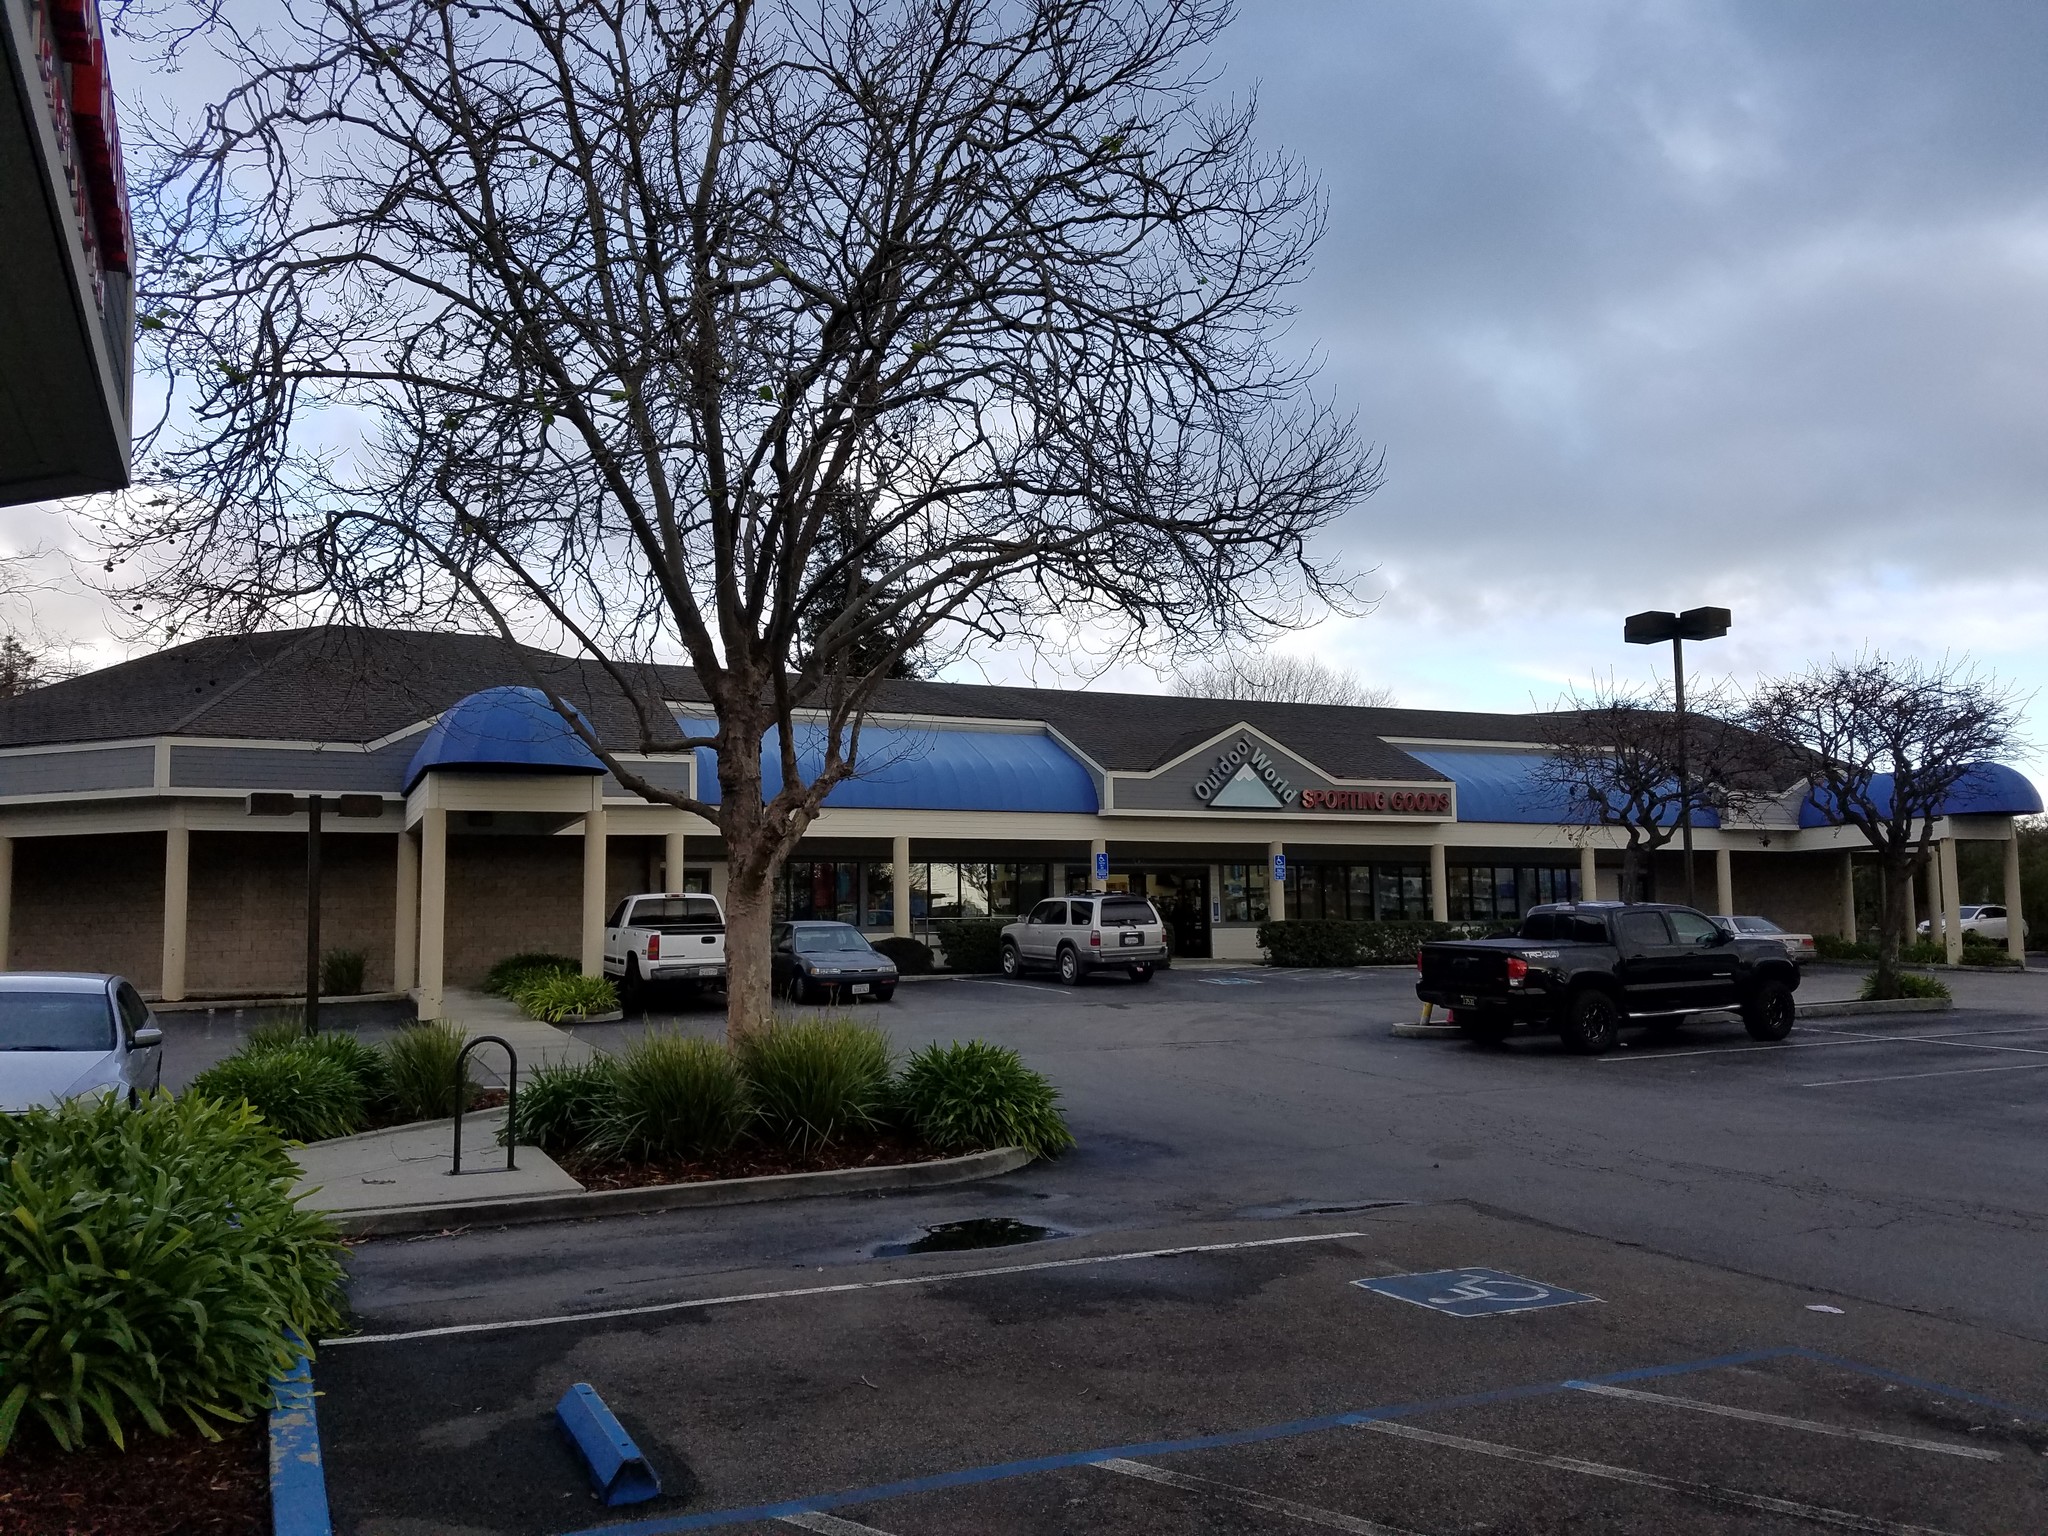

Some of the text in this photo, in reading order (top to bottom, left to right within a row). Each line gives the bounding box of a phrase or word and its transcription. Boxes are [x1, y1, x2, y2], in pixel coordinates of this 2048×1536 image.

[1195, 734, 1298, 804] Outdoor World
[1300, 789, 1450, 812] SPORTING GOODS
